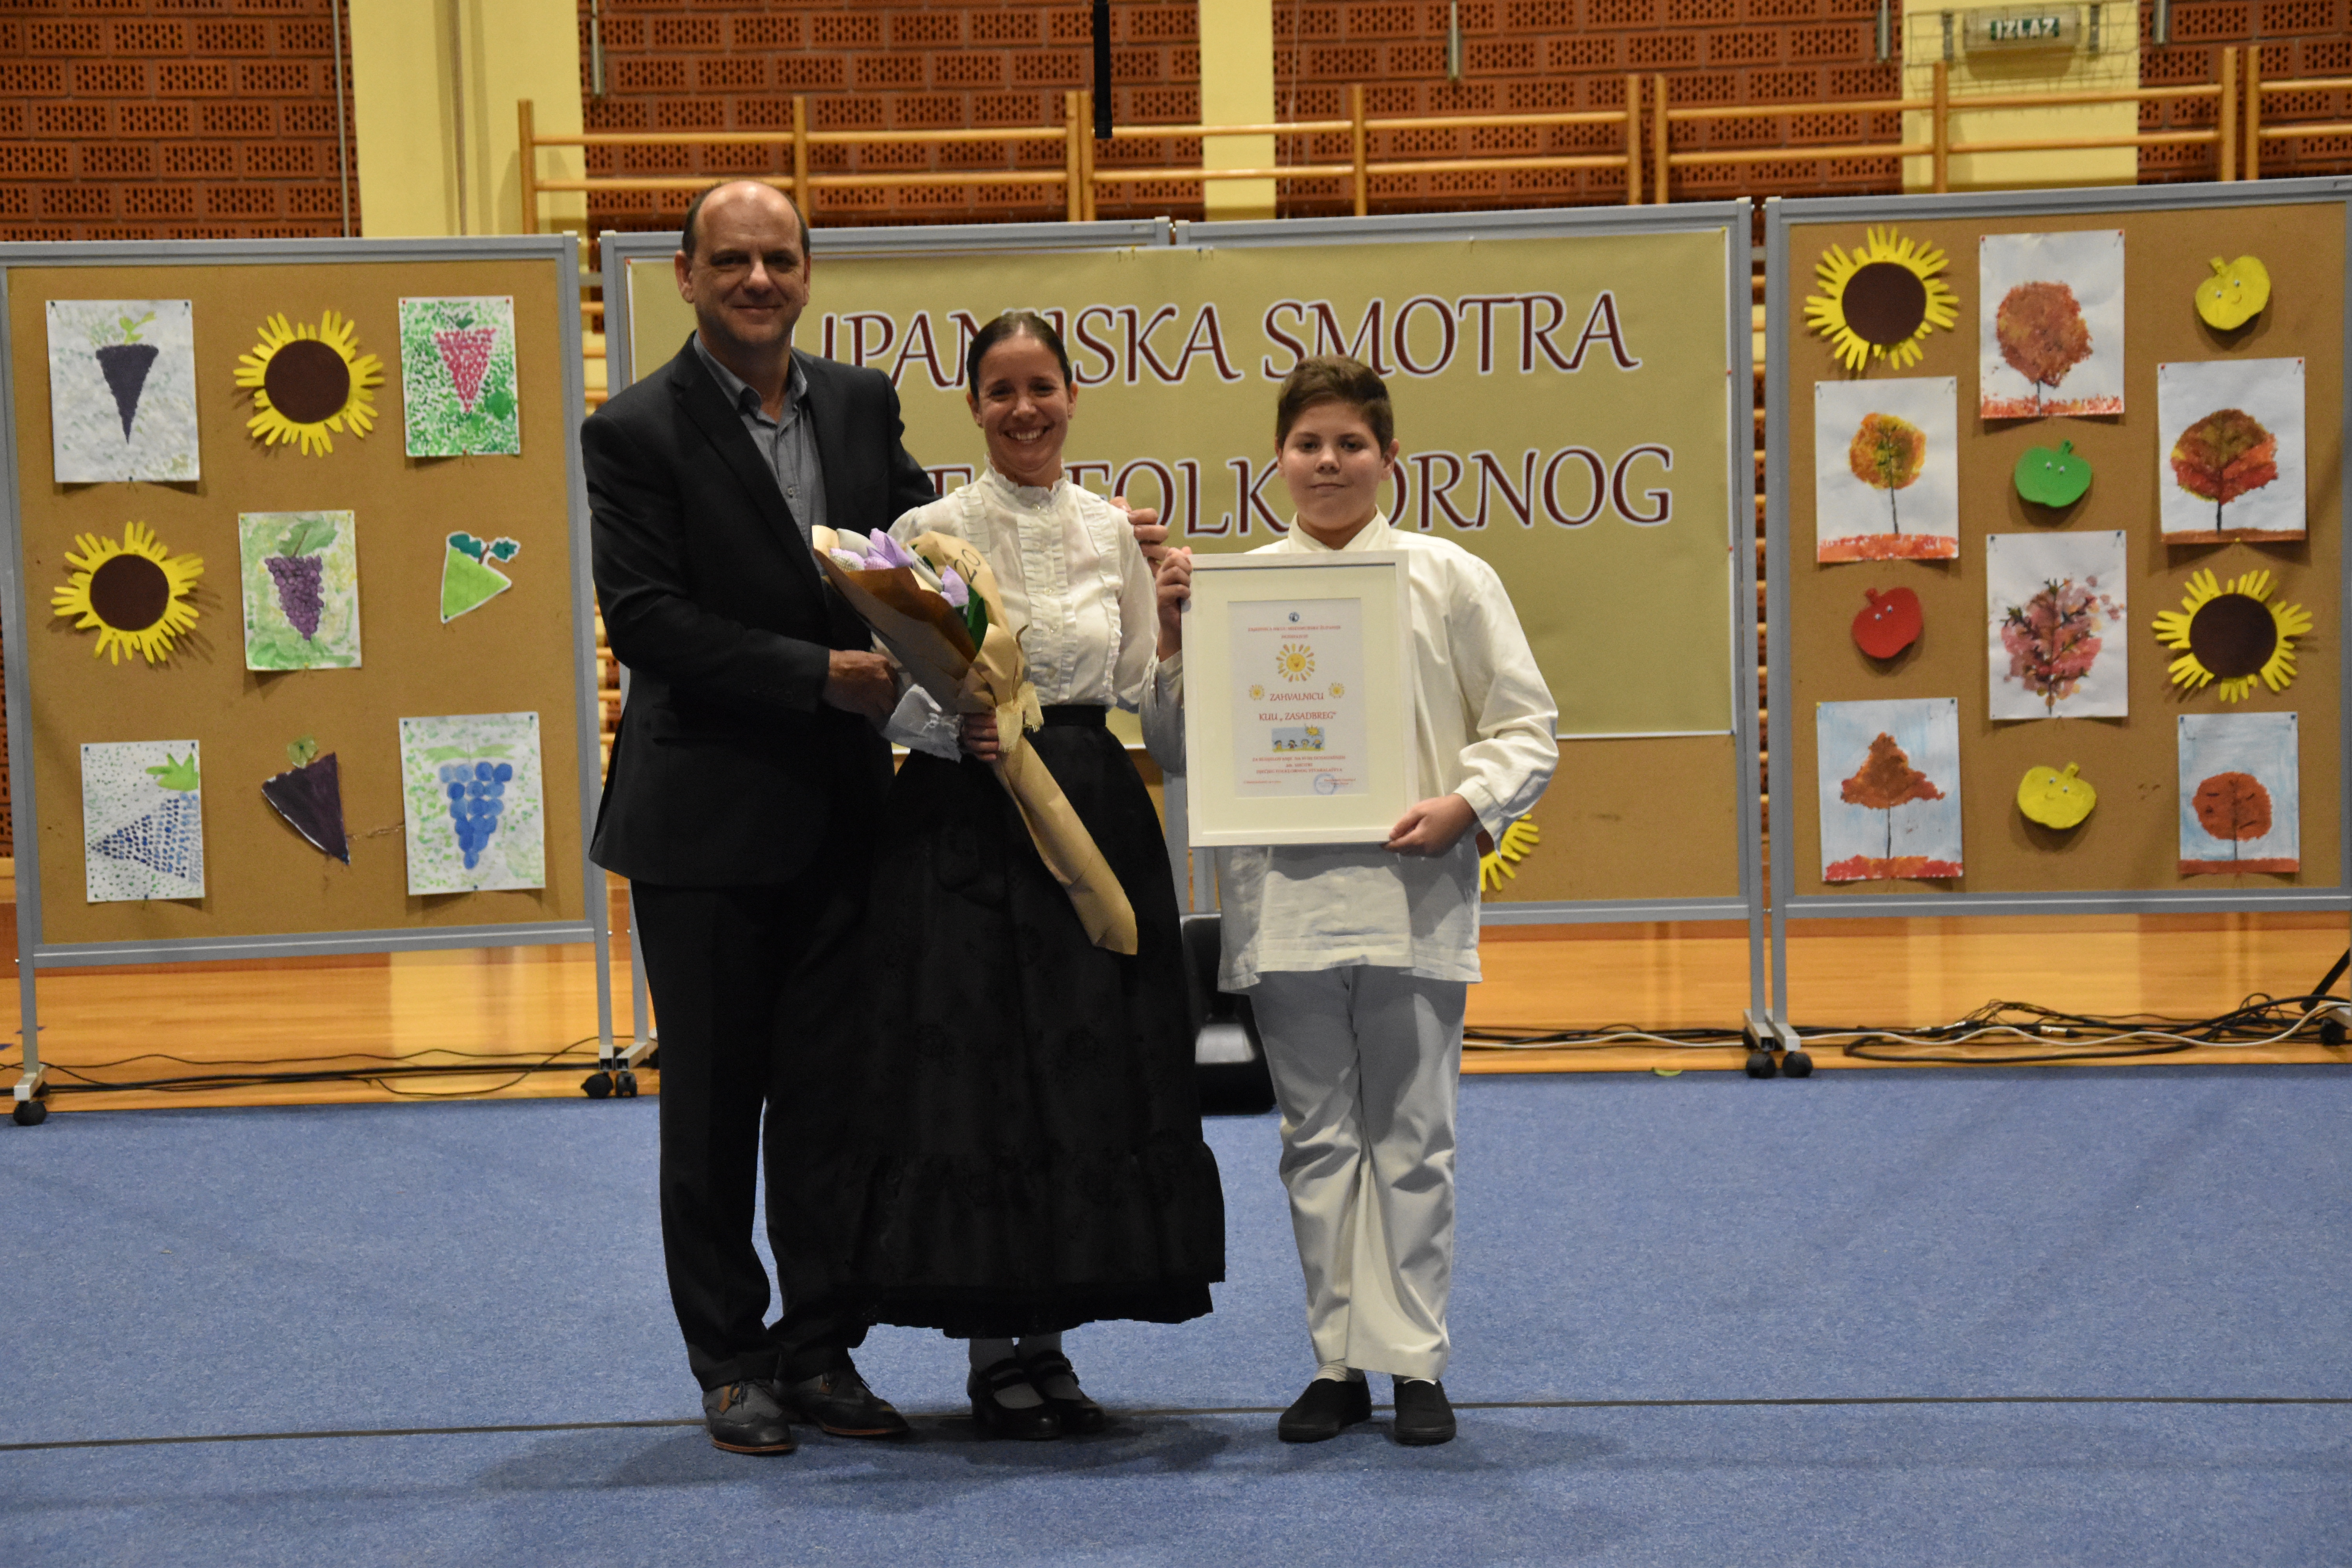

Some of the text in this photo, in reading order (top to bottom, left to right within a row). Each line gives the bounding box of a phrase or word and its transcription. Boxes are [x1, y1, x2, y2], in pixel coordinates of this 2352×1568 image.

[1996, 18, 2055, 38] IZLAZ
[1263, 292, 1640, 380] SMOTRA
[1063, 447, 1671, 536] OLKRNOG
[1270, 692, 1324, 701] ZAHVALNICU
[1259, 713, 1278, 721] KUU
